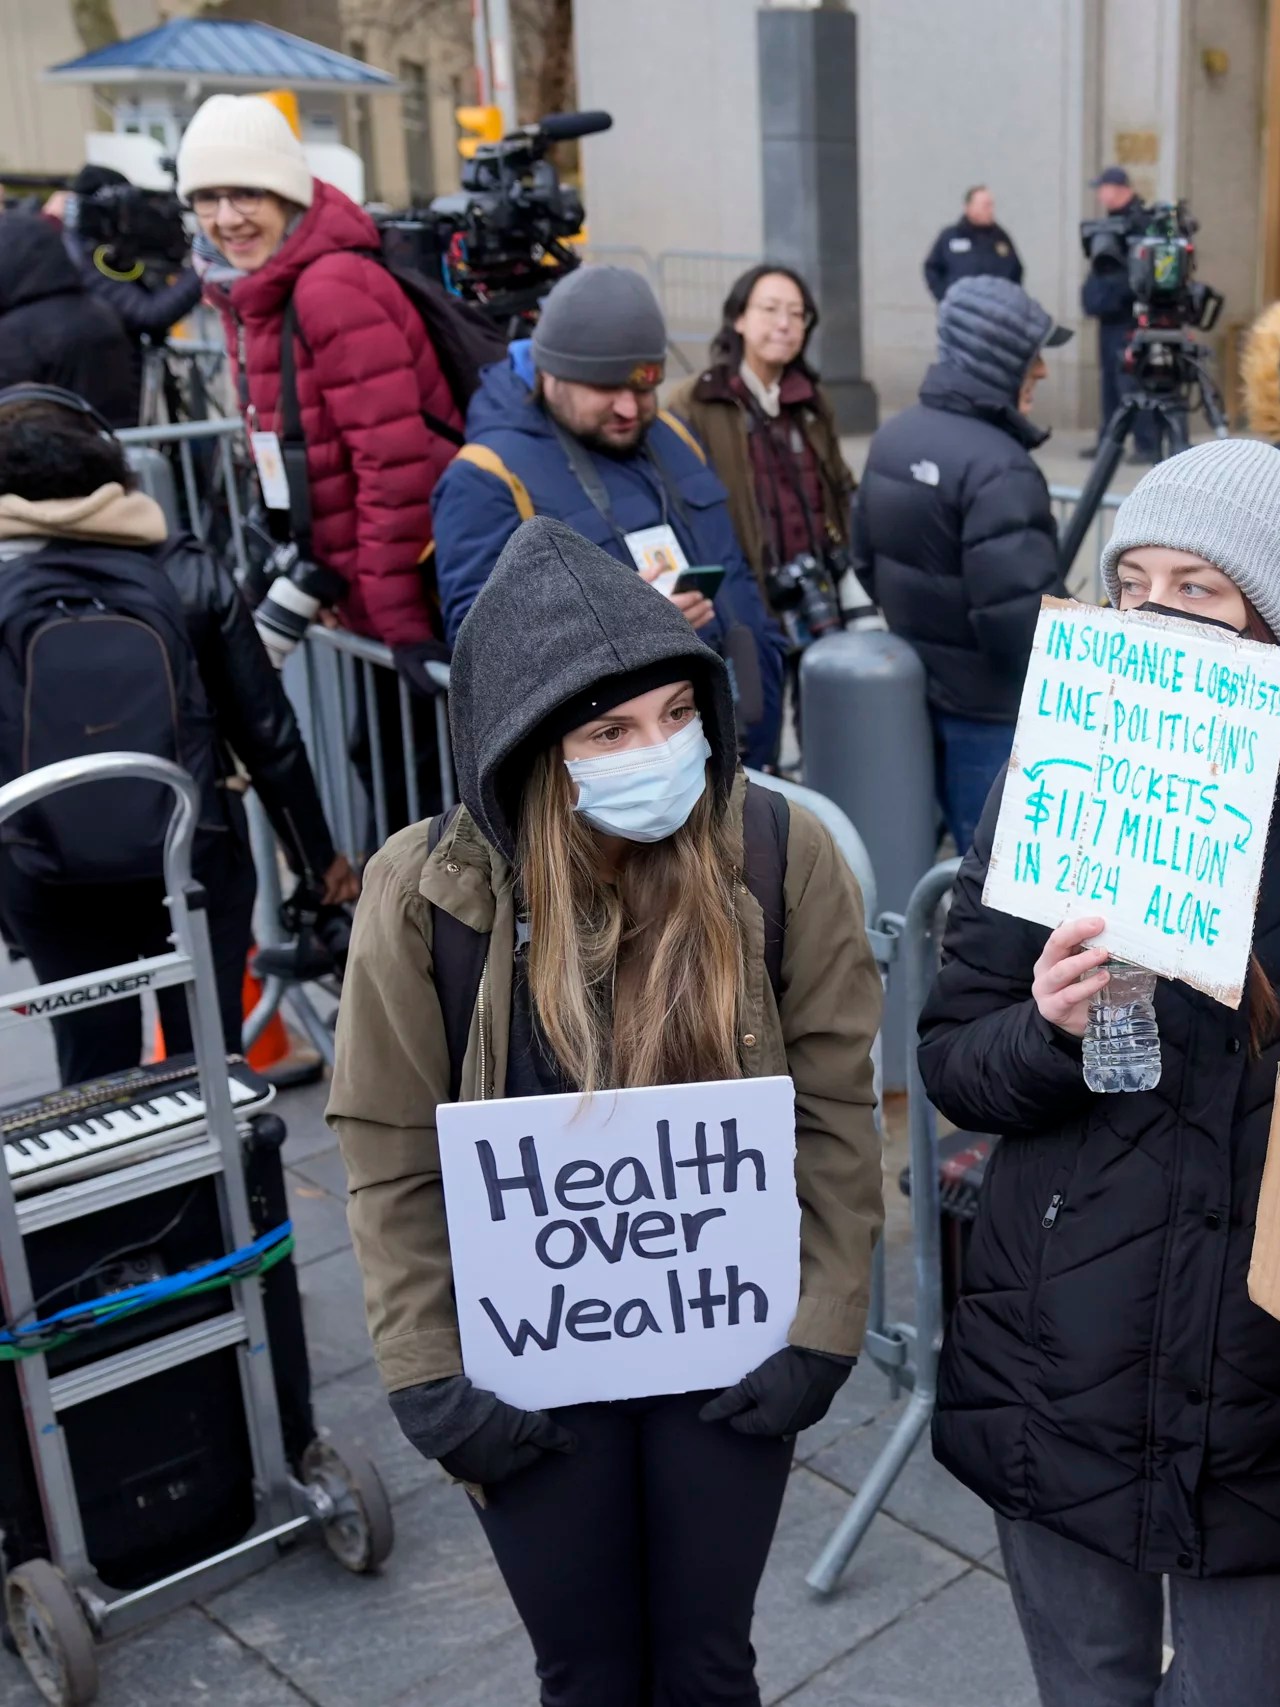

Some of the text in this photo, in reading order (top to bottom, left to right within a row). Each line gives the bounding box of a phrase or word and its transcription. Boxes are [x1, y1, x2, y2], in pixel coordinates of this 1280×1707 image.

[1045, 619, 1187, 694] INSURANCE
[1037, 678, 1259, 775] LINE POLITICIAN'S
[1023, 777, 1230, 888] $117 MILLION
[1096, 753, 1221, 826] POCKETS
[1013, 840, 1223, 948] IN 2024 ALONE
[28, 974, 150, 1015] MAGLINER
[474, 1117, 767, 1222] Health
[535, 1207, 727, 1270] over
[478, 1265, 769, 1357] Wealth
